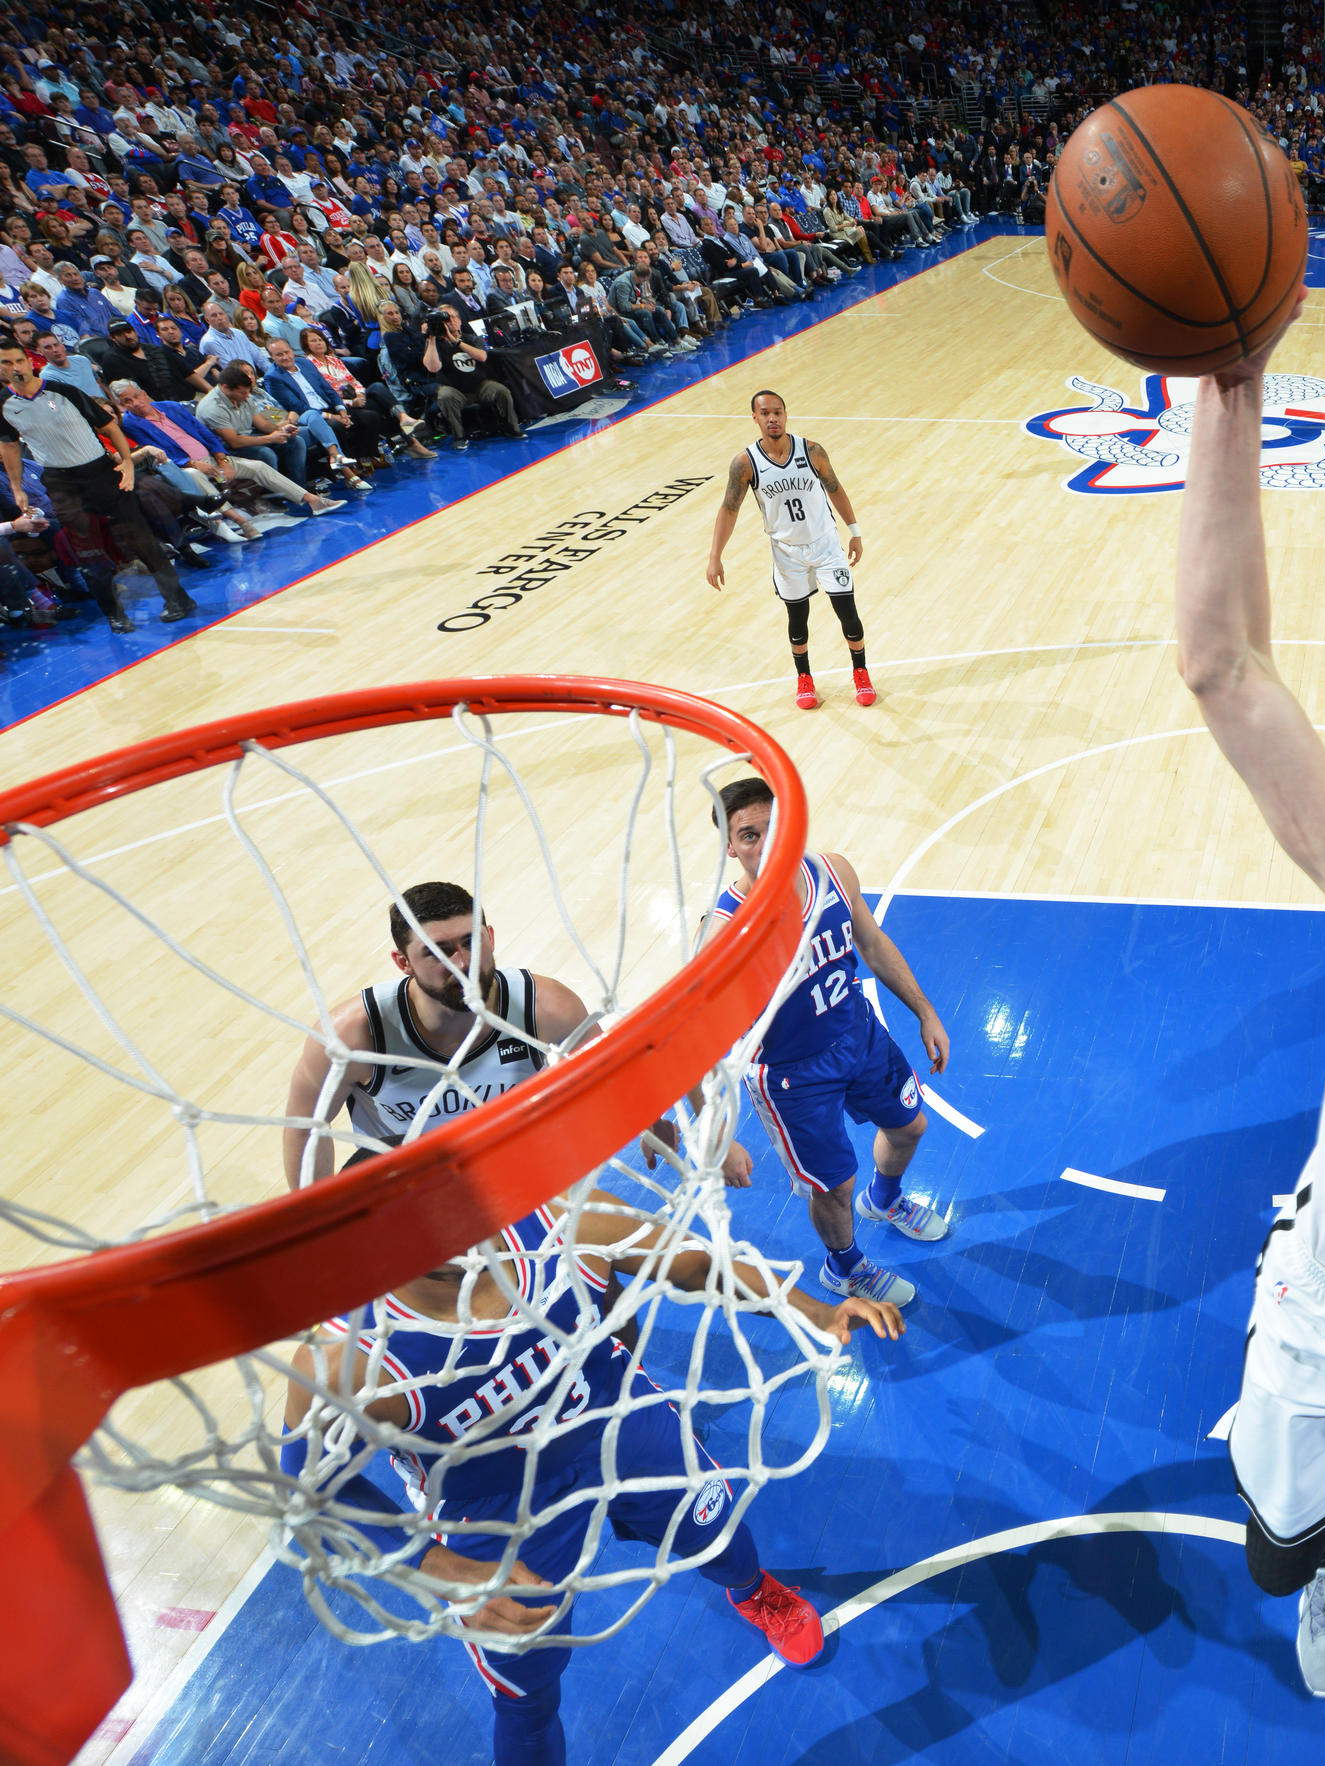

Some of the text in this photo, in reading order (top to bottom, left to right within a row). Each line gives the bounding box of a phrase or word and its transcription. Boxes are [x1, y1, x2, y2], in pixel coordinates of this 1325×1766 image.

[543, 357, 594, 389] NBA TNT
[761, 477, 816, 499] BROOKLYN
[784, 498, 806, 522] 13
[437, 475, 714, 633] WELLS FARGO
[475, 511, 606, 576] CENTER
[811, 969, 849, 1017] 12
[499, 1043, 526, 1057] infor
